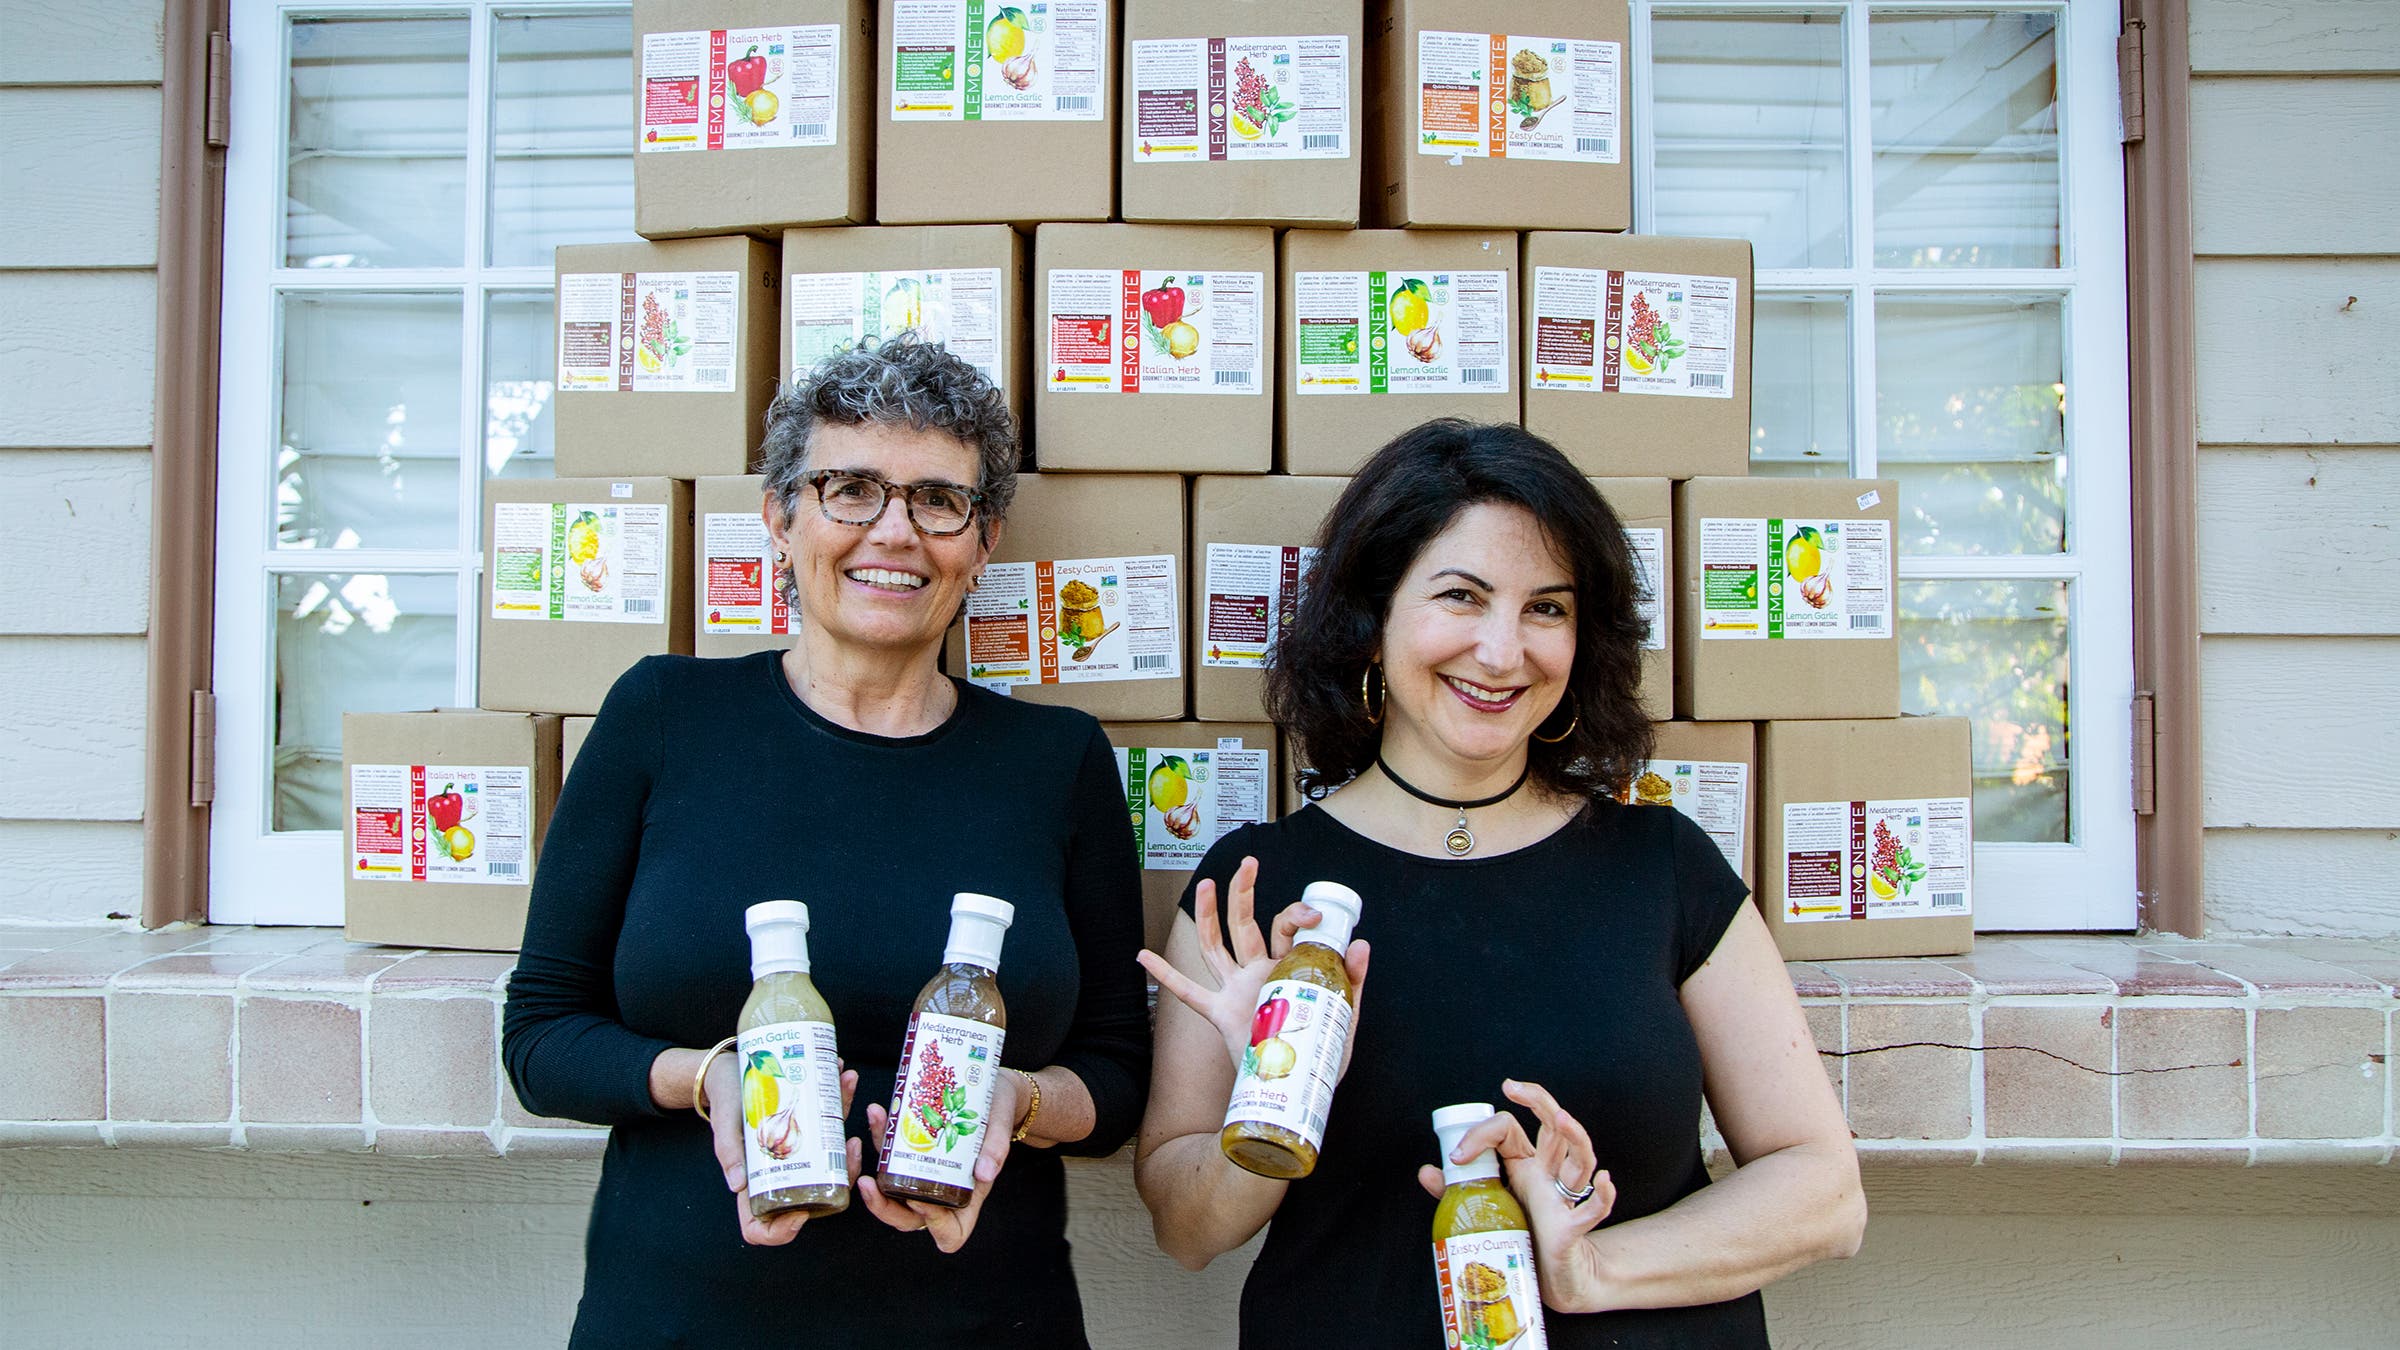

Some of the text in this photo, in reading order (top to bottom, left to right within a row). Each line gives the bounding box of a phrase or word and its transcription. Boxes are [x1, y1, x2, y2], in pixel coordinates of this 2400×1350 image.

[729, 33, 783, 44] Italian Herb
[1230, 44, 1287, 52] Mediterranean
[967, 5, 983, 115] LEMONETTE
[709, 35, 726, 145] LEMONETTE
[985, 94, 1042, 102] Lemon Garlic
[1211, 43, 1225, 155] LEMONETTE
[1491, 39, 1506, 152] LEMONETTE
[1509, 132, 1563, 142] Zesty Cumin
[1627, 279, 1680, 288] Mediterranean
[621, 279, 635, 386] LEMONETTE
[1124, 276, 1139, 388] LEMONETTE
[1371, 277, 1386, 388] LEMONETTE
[1605, 276, 1622, 388] LEMONETTE
[1143, 365, 1200, 374] Italian Herb
[1390, 366, 1448, 374] Lemon Garlic
[1057, 564, 1115, 575] Zesty Cumin
[1769, 524, 1783, 633] LEMONETTE
[1038, 567, 1057, 679] LEMONETTE
[1786, 612, 1838, 620] Lemon Garlic
[428, 771, 477, 780] Italian Herb
[412, 771, 425, 877] LEMONETTE
[1148, 842, 1205, 851] Lemon Garlic
[1852, 807, 1865, 914] LEMONETTE
[765, 1029, 800, 1043] Garlic
[920, 1022, 988, 1042] Mediterranean
[940, 1034, 964, 1046] Herb
[880, 1014, 920, 1164] LEMONETTE
[1260, 1089, 1288, 1103] Herb
[1450, 1239, 1520, 1256] Zesty Cumin
[1437, 1247, 1459, 1348] ONETTE
